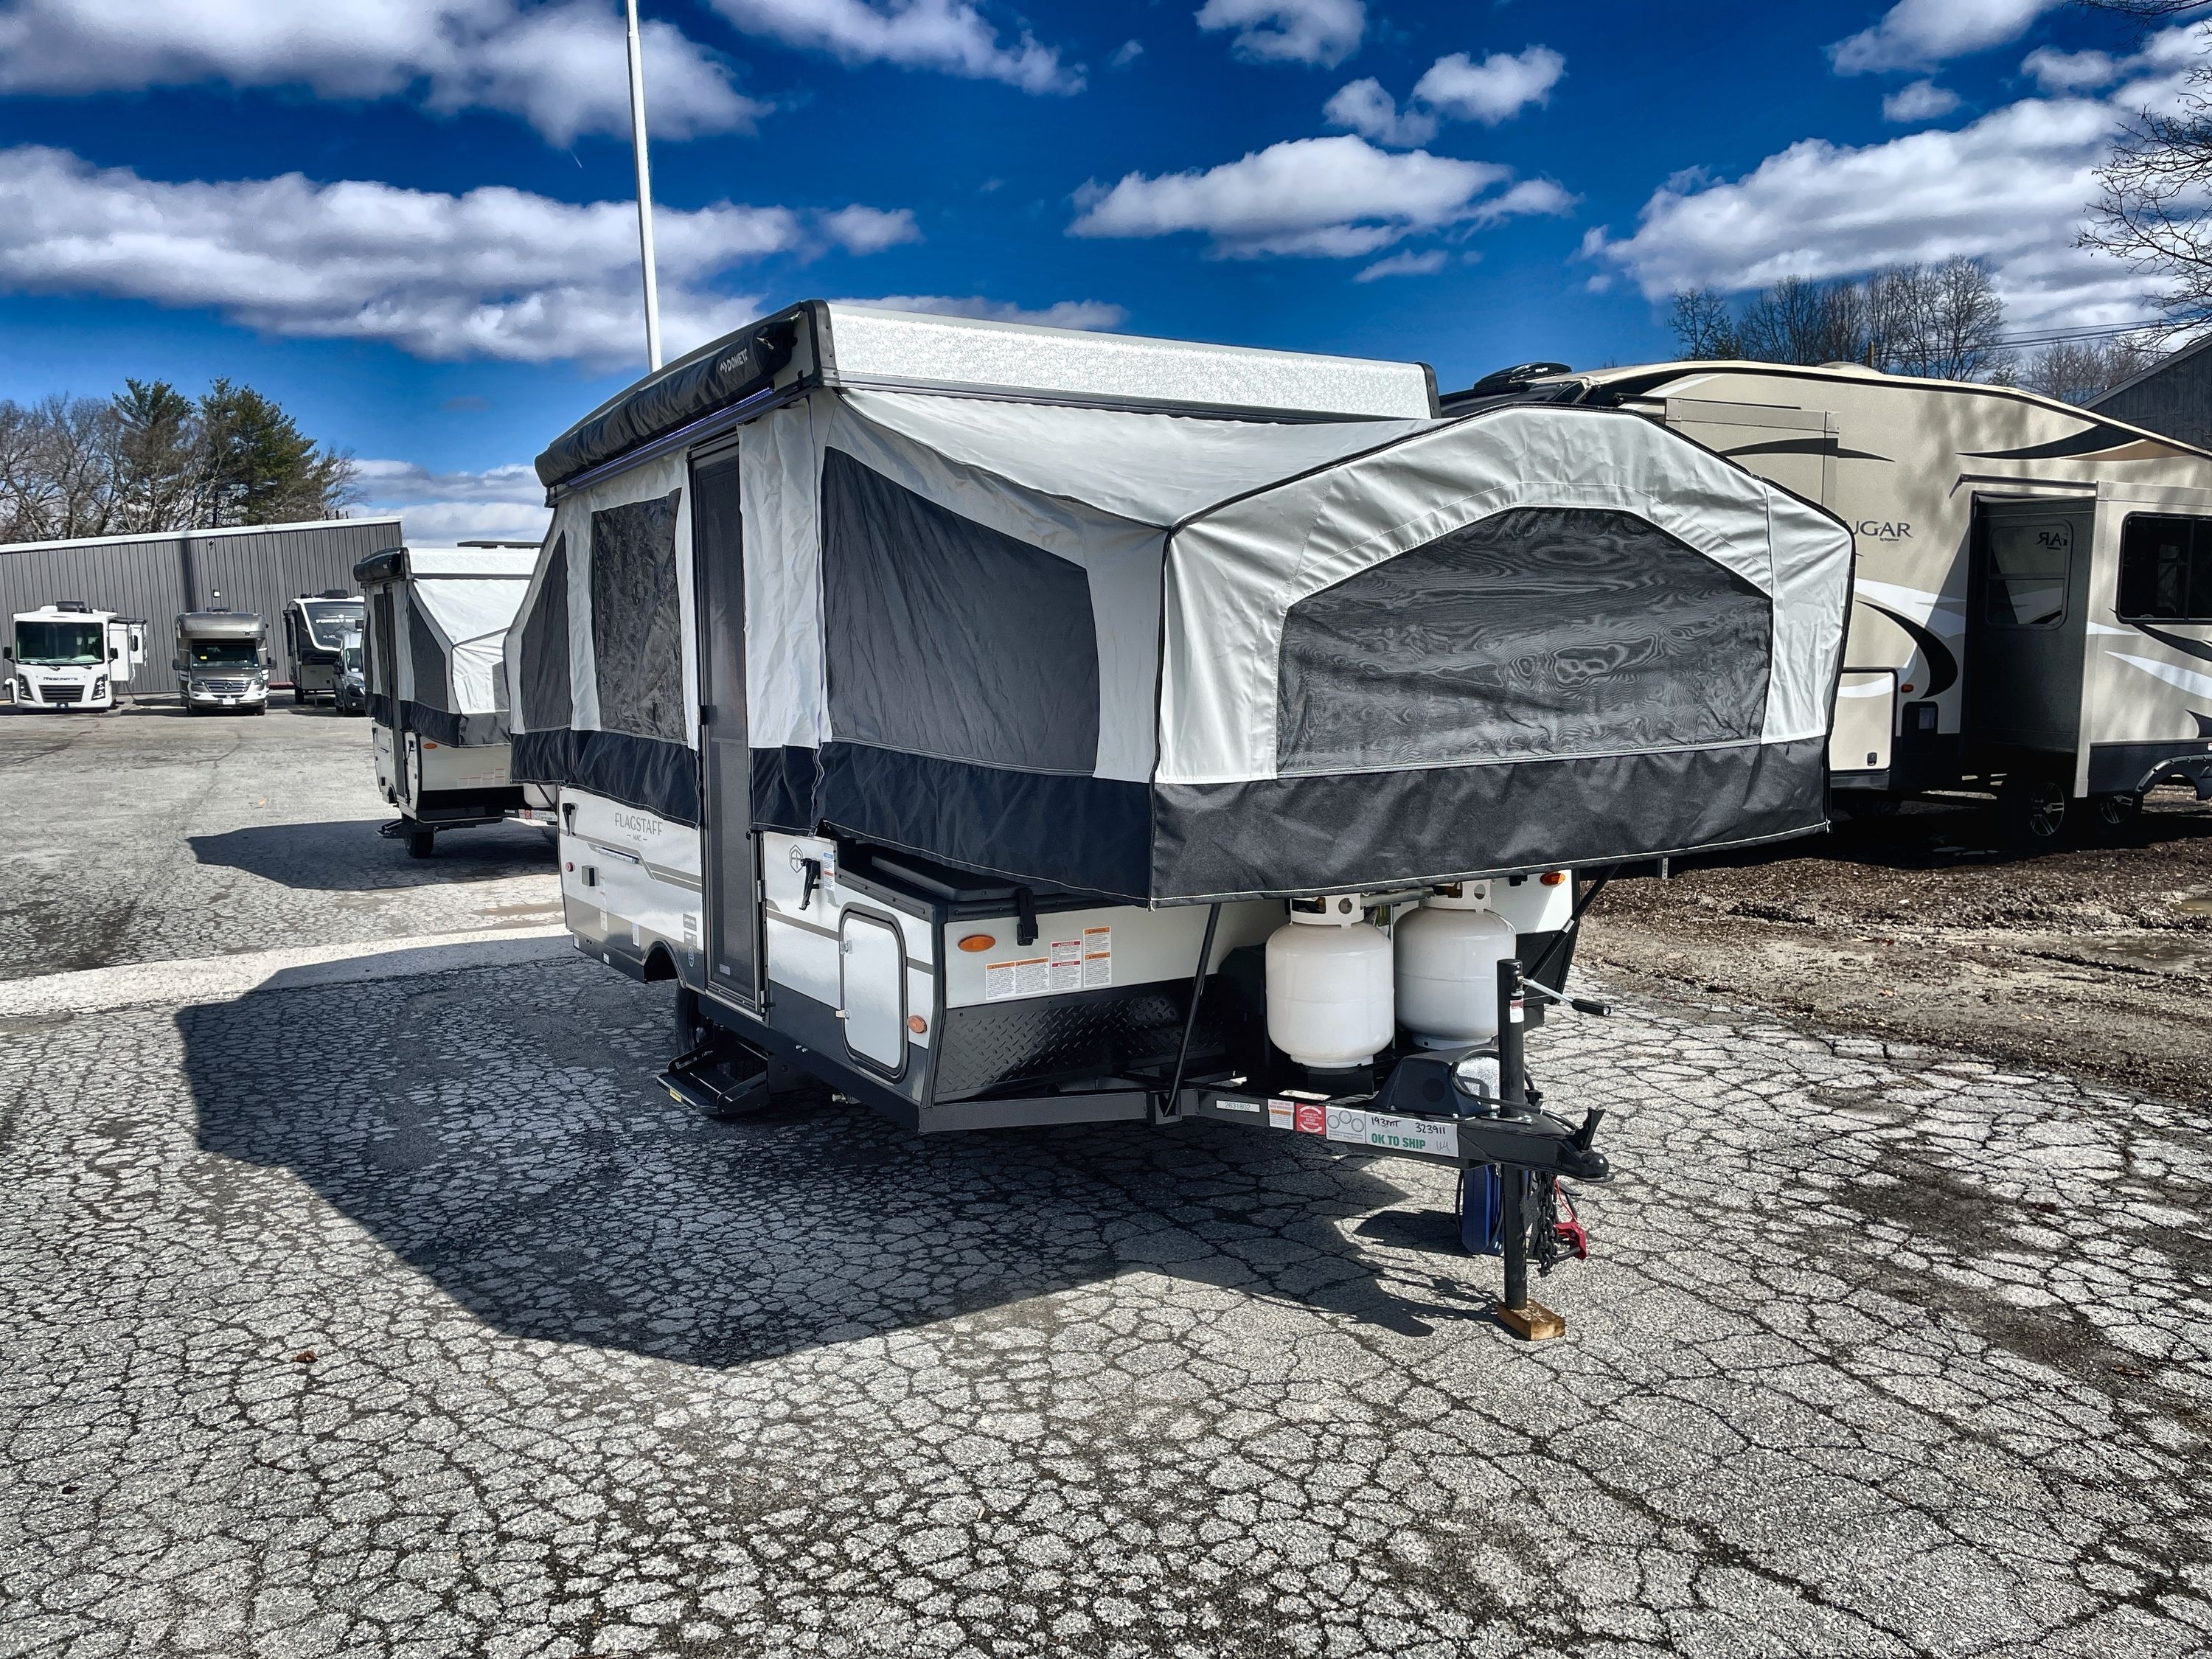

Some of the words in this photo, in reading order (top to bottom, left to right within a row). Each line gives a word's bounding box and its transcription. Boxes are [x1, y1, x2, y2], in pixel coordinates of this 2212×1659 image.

[1851, 521, 1913, 538] UGAR
[614, 812, 663, 836] FLAGSTAFF
[1225, 1102, 1251, 1110] 2631802
[1415, 1122, 1445, 1134] 323911
[1371, 1133, 1385, 1144] OK
[1387, 1135, 1399, 1147] TO
[1402, 1137, 1426, 1150] SHIP
